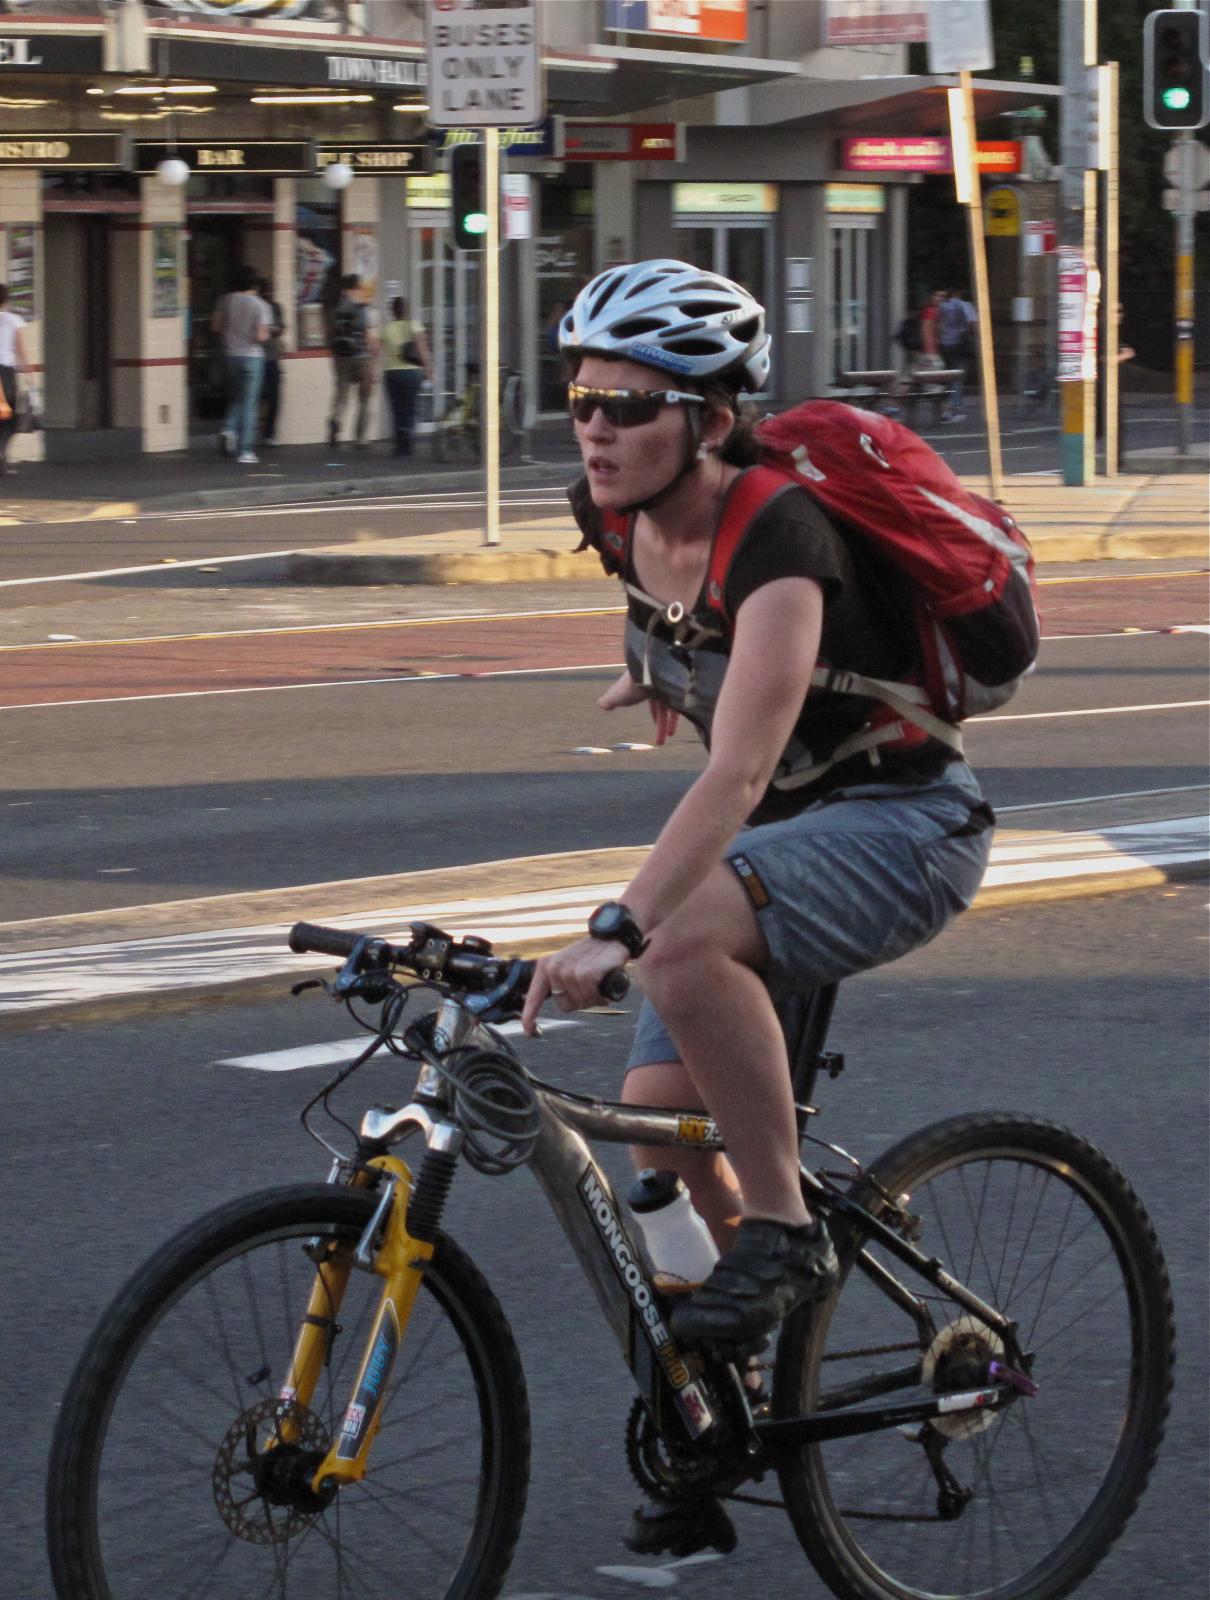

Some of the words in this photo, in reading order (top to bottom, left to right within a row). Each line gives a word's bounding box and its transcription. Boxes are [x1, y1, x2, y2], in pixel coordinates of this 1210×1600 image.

[432, 24, 533, 47] BUSES
[441, 56, 526, 79] ONLY
[442, 88, 526, 111] LANE
[197, 150, 246, 165] BAR
[355, 152, 414, 167] SHOP
[583, 1172, 668, 1347] MONGOOSE
